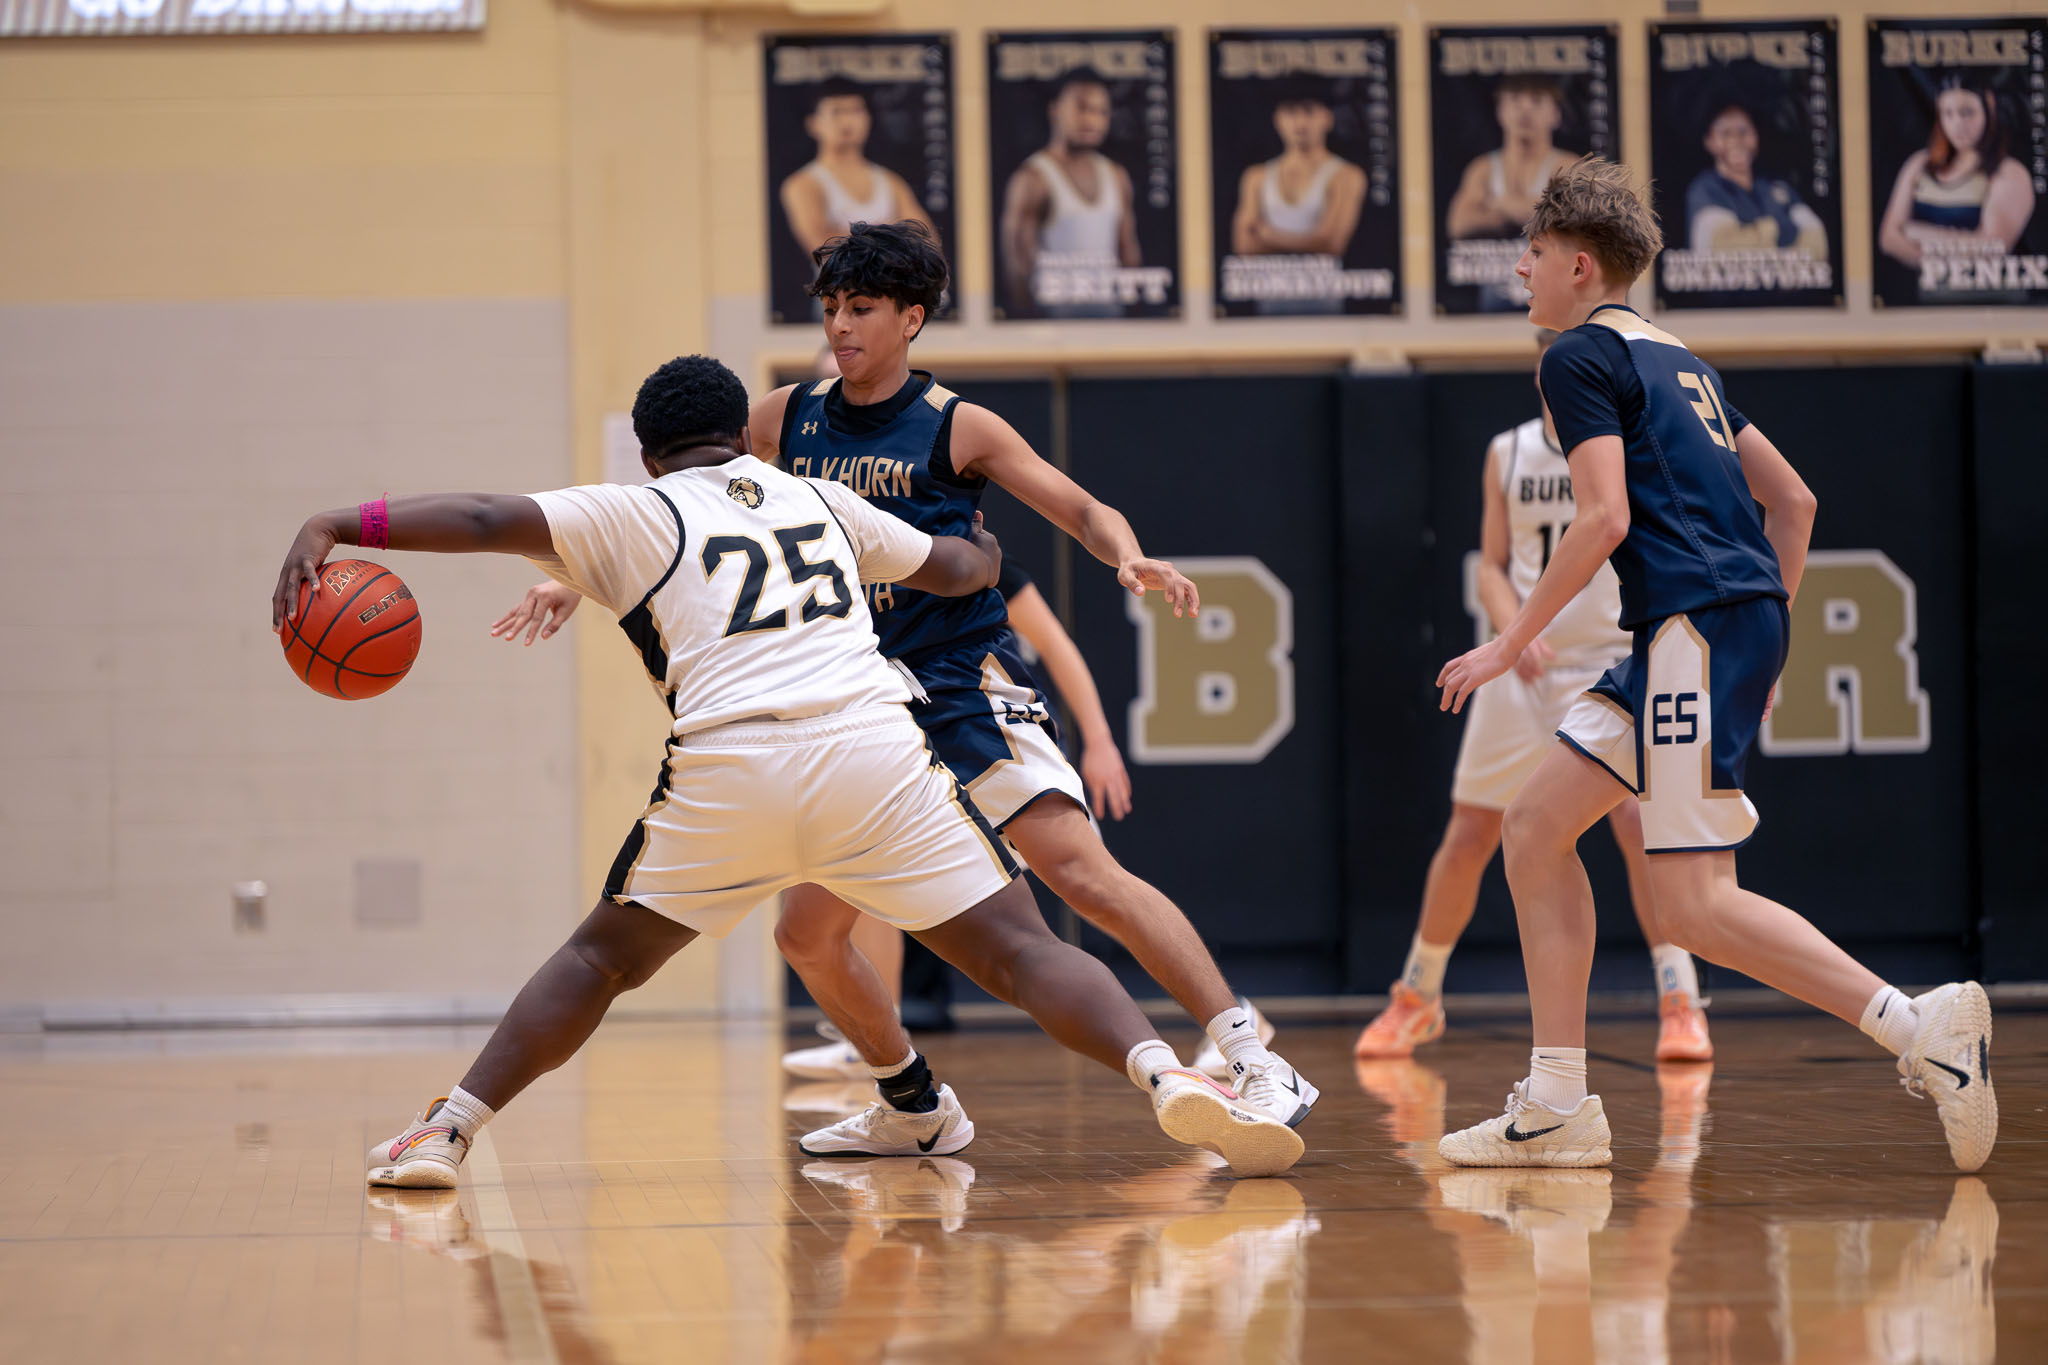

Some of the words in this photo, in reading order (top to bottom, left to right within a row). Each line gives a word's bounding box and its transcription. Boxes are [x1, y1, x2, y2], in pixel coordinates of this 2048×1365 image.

[1881, 29, 2029, 67] BURKE
[1919, 255, 2048, 290] PENIX
[1677, 371, 1737, 452] 21
[699, 520, 853, 639] 25
[1652, 692, 1698, 745] ES
